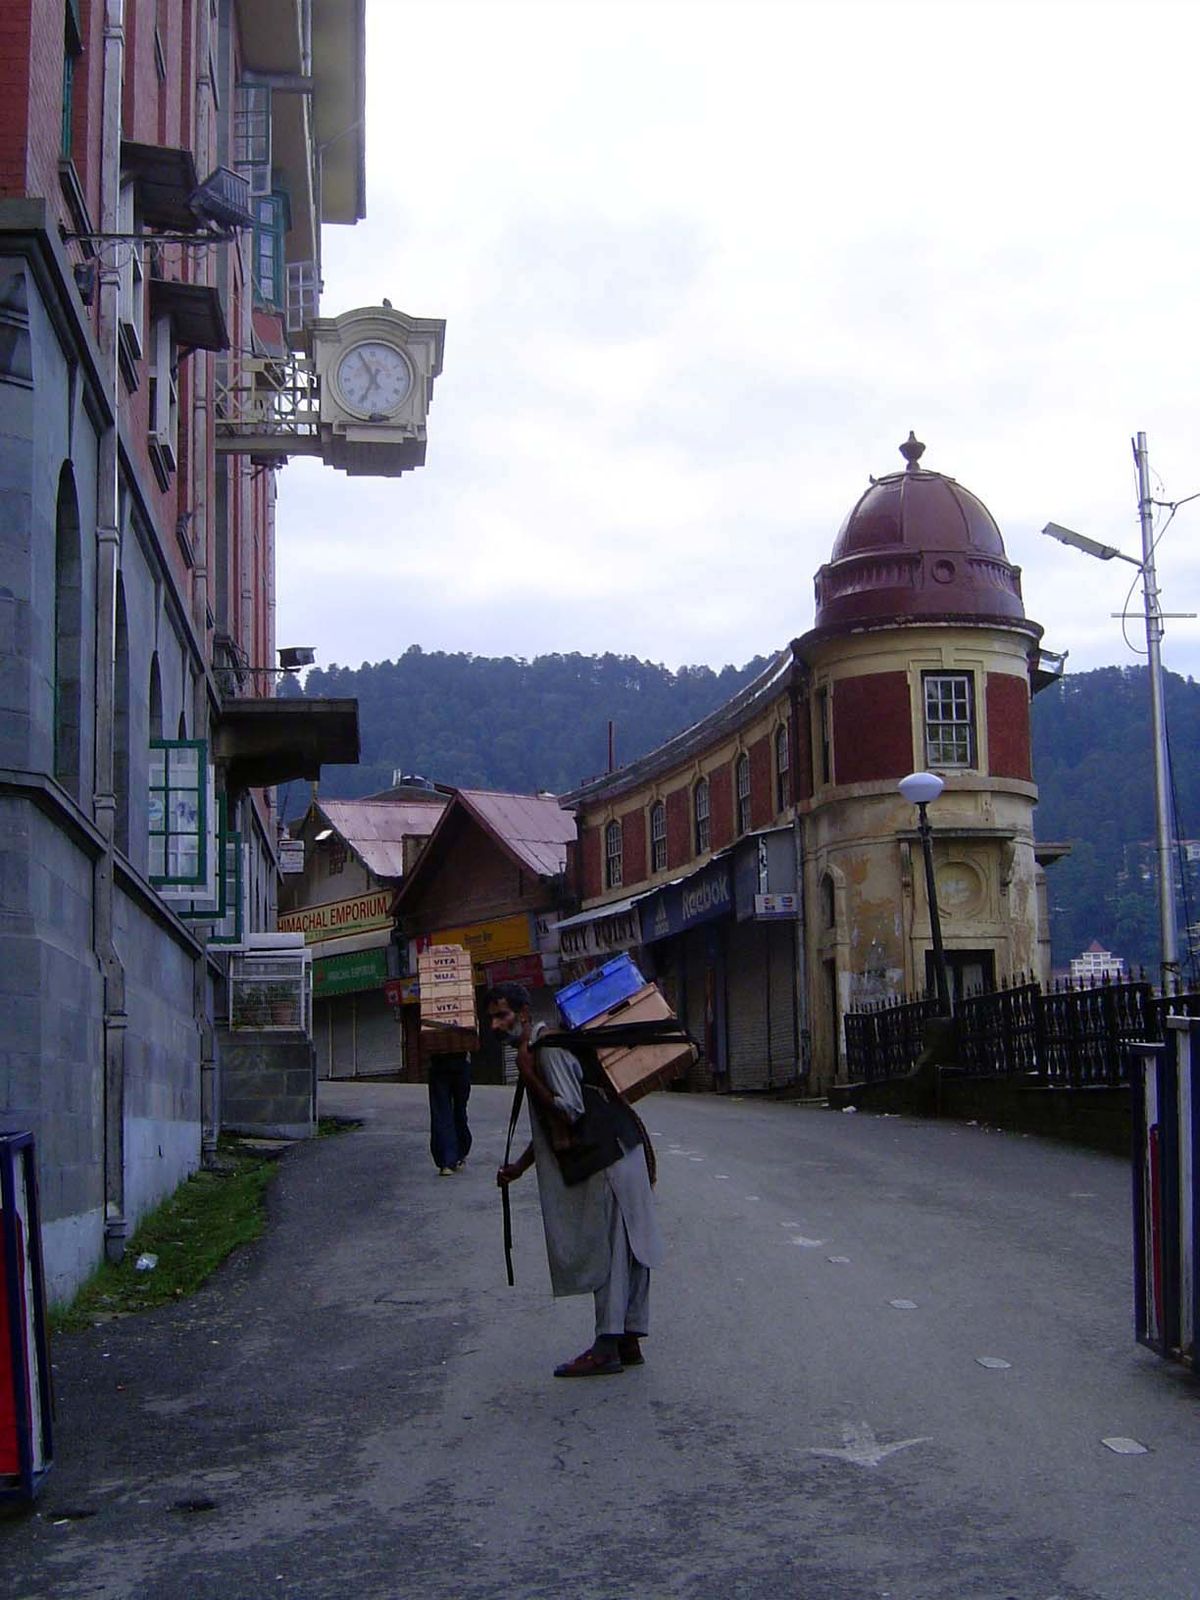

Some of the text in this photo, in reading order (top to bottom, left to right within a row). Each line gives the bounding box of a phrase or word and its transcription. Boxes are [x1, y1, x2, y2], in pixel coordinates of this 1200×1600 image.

[277, 896, 389, 932] HIMACHAL EMPORIUM
[560, 926, 588, 953] CITY
[592, 914, 637, 947] POINT
[434, 958, 455, 966] VITA
[437, 1003, 458, 1011] VITA
